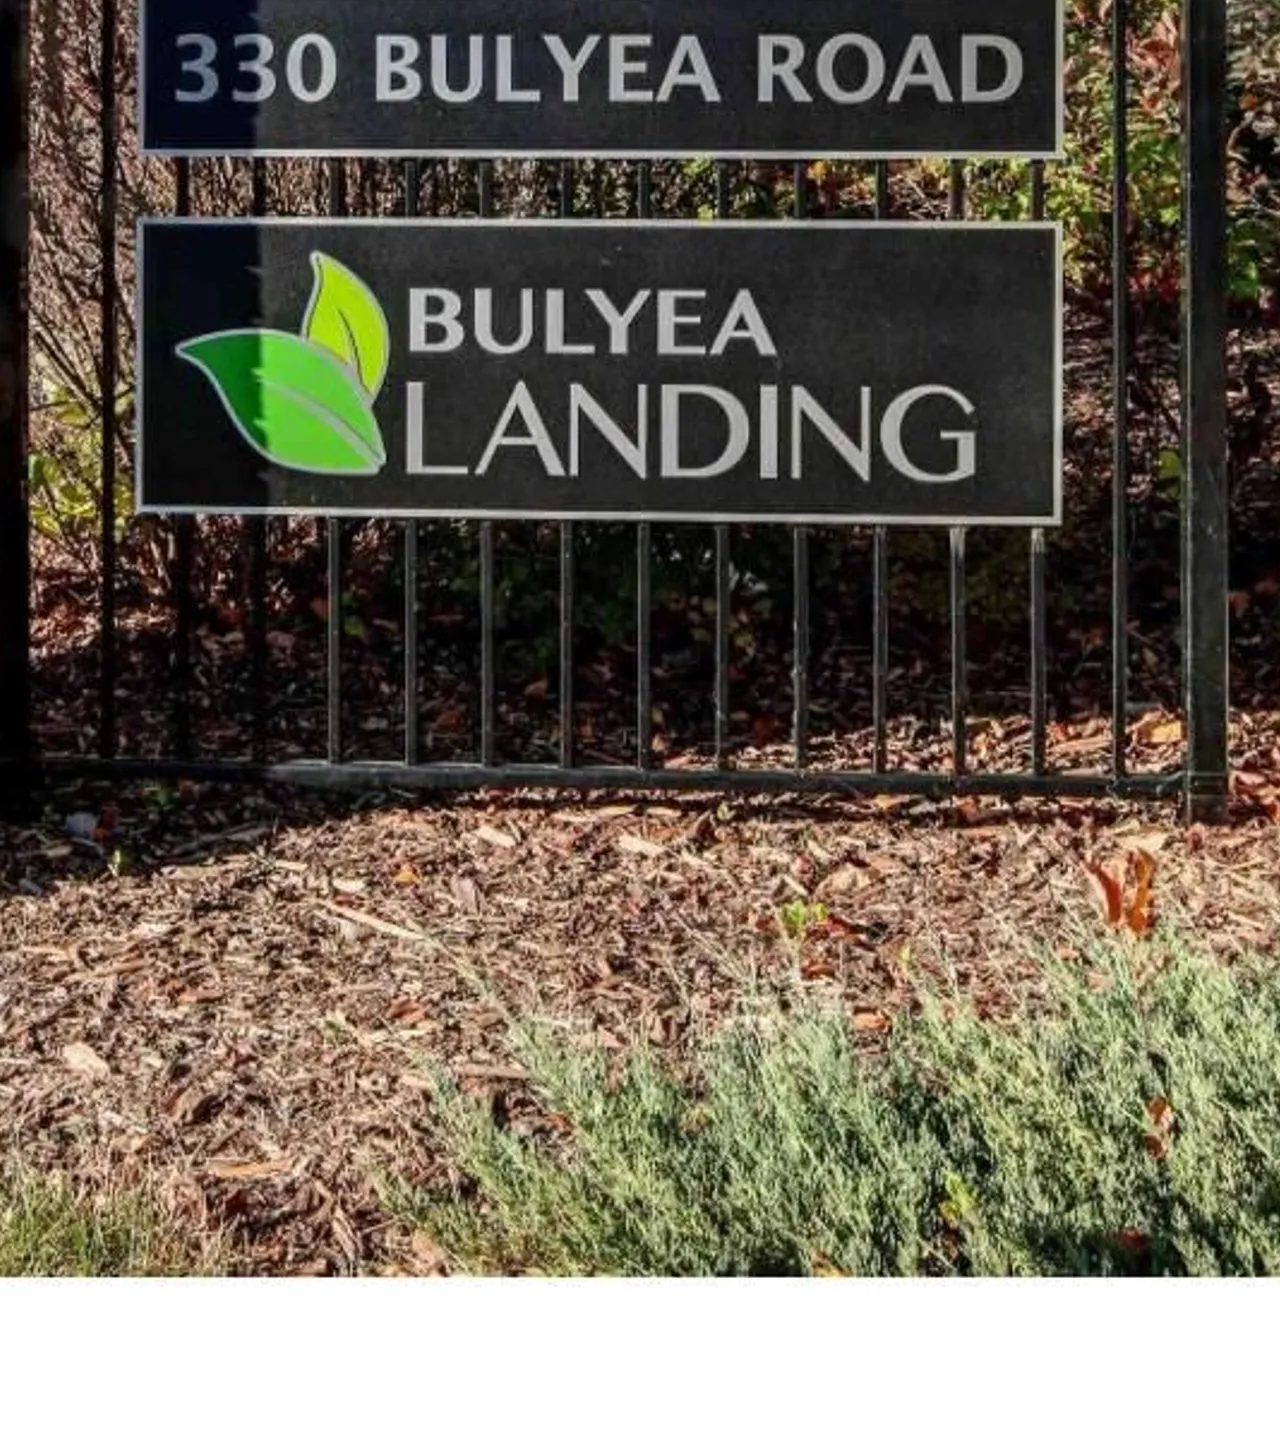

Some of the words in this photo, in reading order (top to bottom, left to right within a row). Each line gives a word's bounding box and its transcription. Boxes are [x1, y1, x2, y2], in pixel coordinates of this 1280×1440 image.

[174, 32, 338, 103] 330
[374, 33, 720, 103] BULYEA
[756, 32, 1024, 103] ROAD
[408, 286, 778, 357] BULYEA
[405, 380, 977, 483] LANDING
